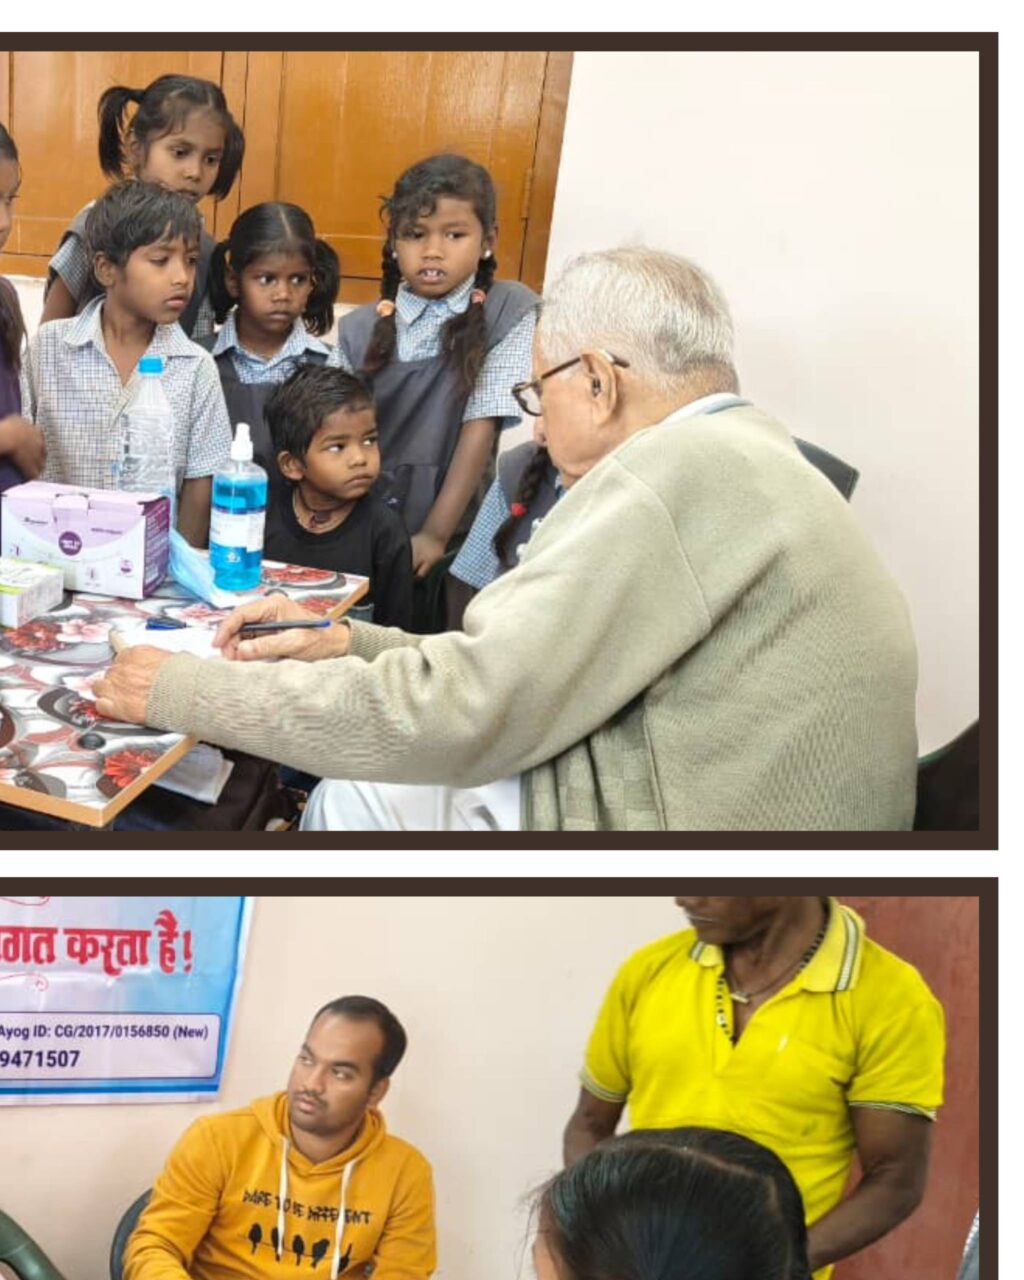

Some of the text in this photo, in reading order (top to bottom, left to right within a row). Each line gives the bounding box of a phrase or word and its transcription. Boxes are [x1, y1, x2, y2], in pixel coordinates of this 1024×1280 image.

[63, 928, 151, 977] करता
[33, 1025, 51, 1038] ID:
[55, 1025, 169, 1039] CG/2017/0156850
[173, 1026, 208, 1040] (New)
